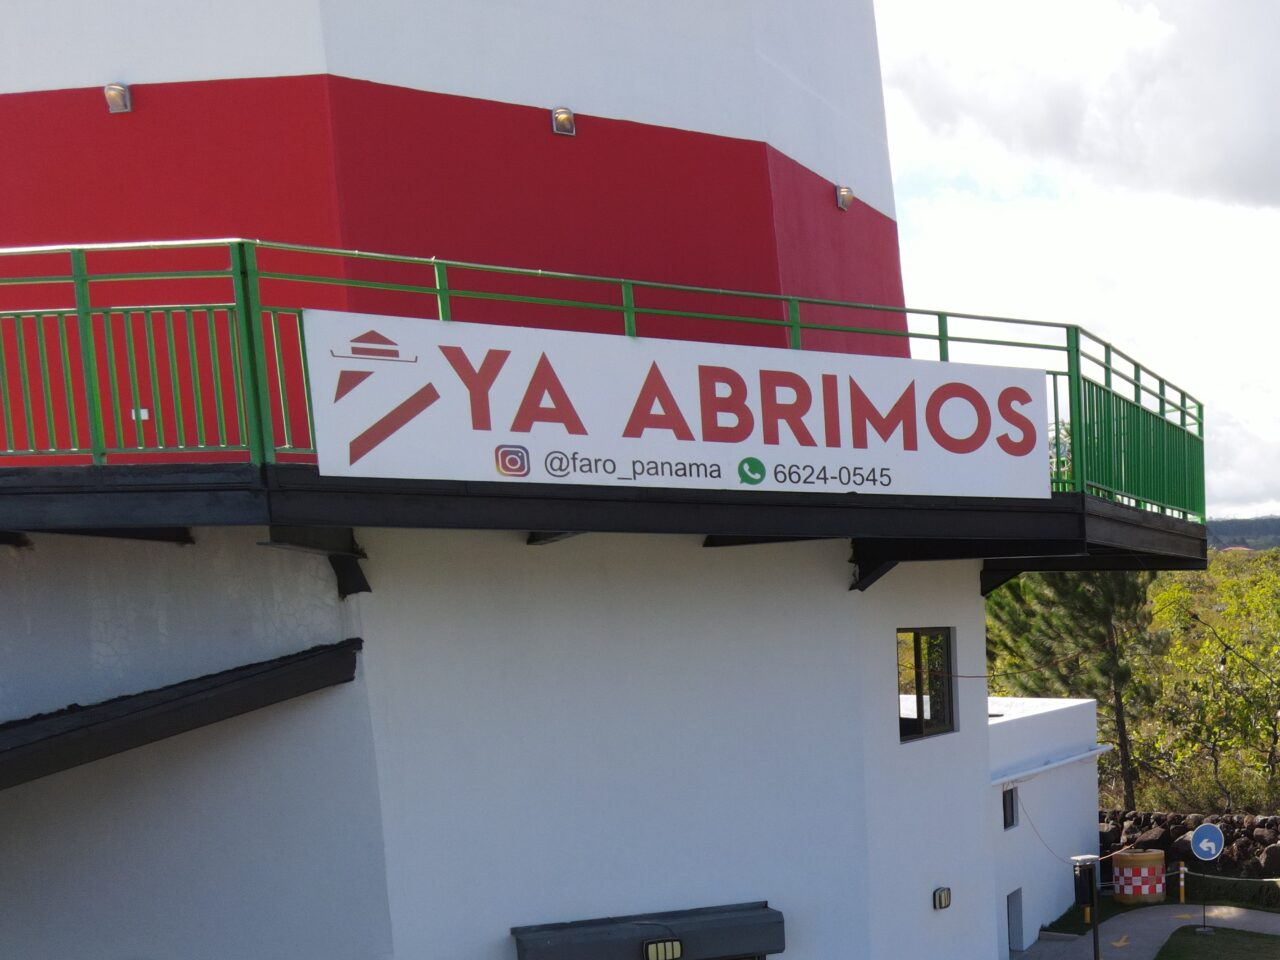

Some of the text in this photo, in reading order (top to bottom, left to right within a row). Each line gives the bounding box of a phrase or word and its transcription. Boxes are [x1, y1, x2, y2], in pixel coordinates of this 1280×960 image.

[438, 345, 1037, 457] YA ABRIMOS
[544, 450, 892, 487] @faro_panama 6624-0545
